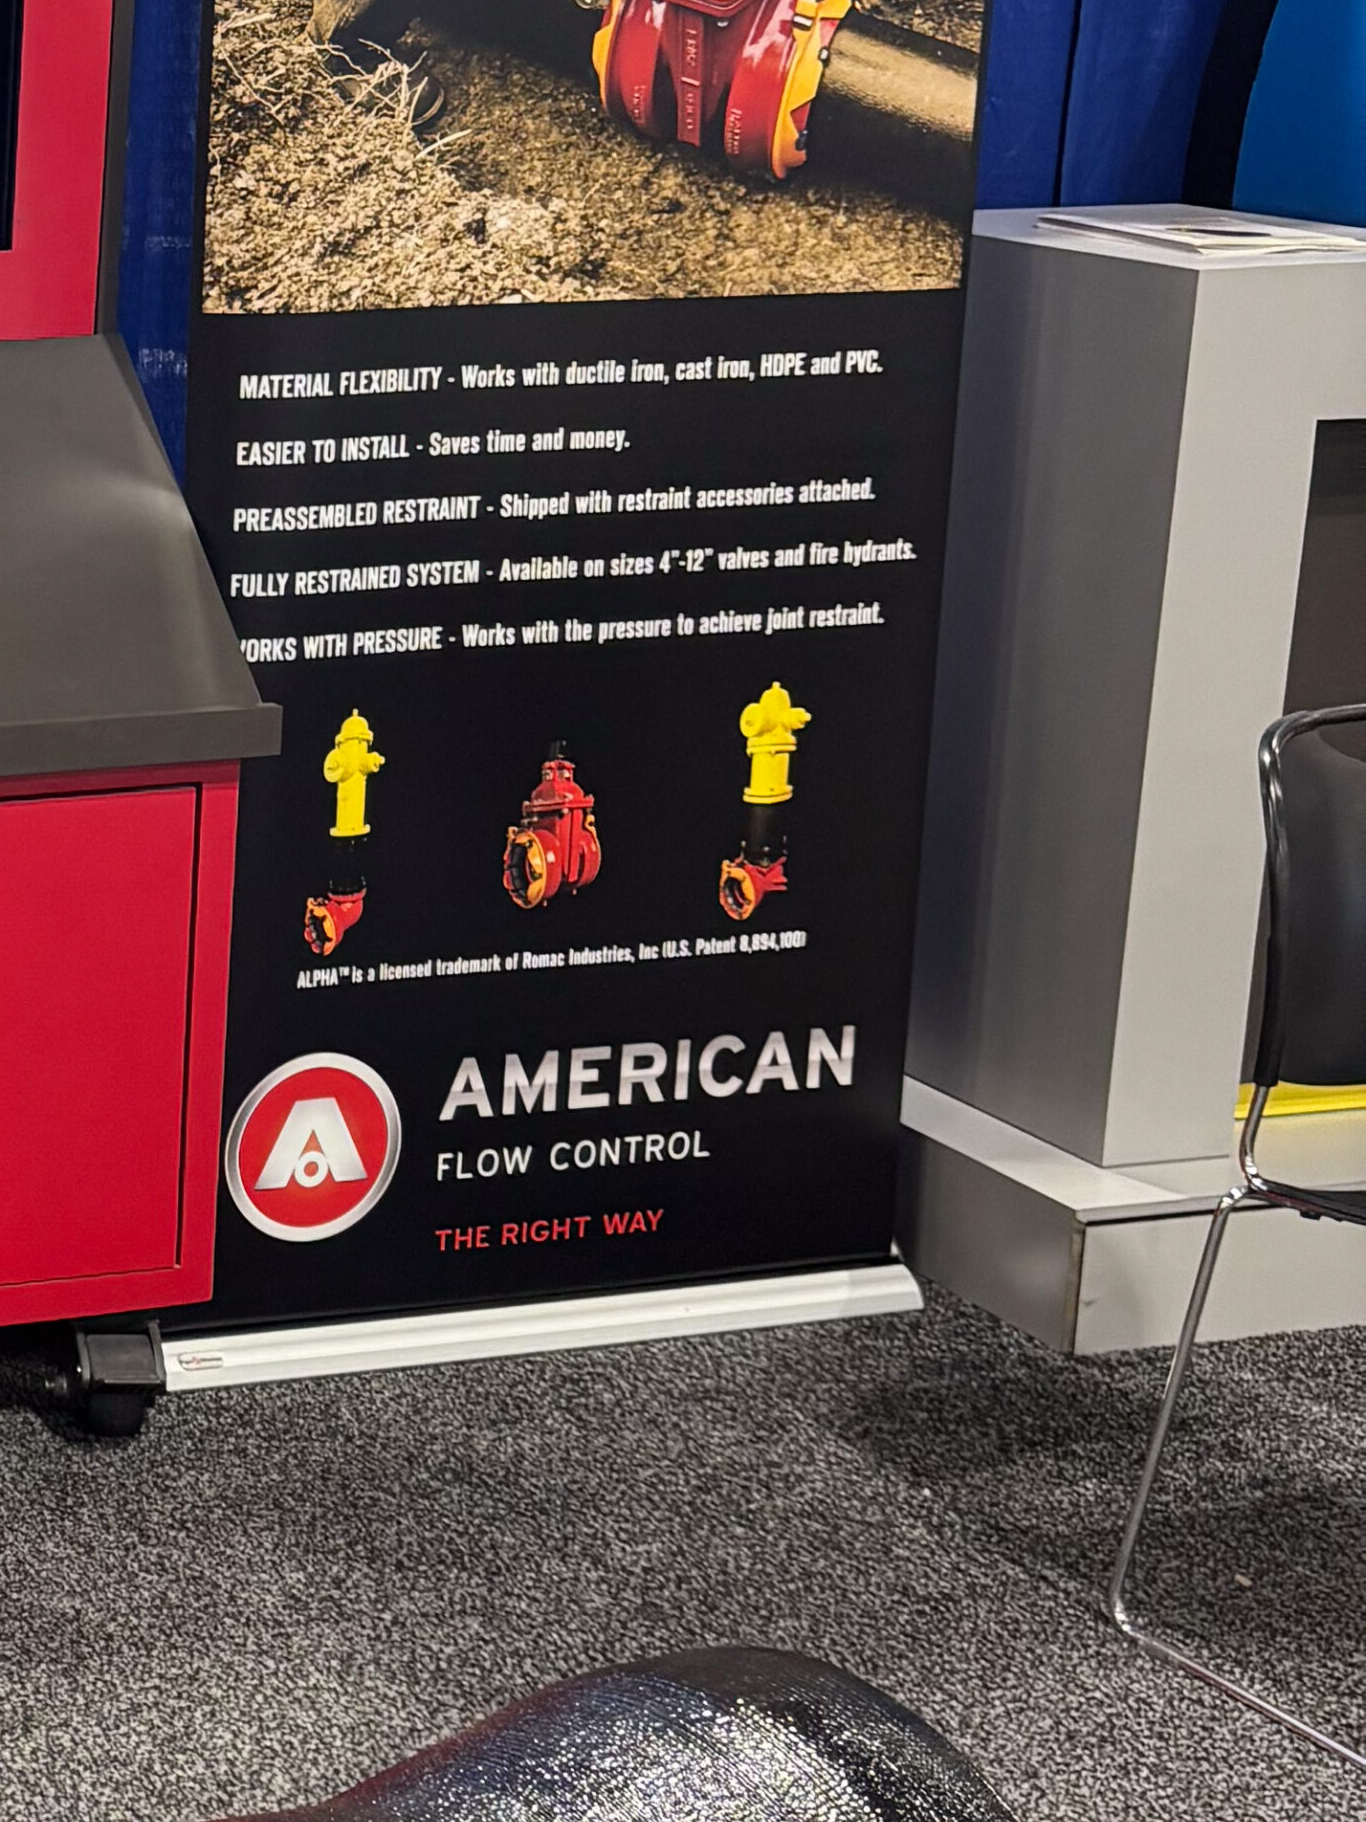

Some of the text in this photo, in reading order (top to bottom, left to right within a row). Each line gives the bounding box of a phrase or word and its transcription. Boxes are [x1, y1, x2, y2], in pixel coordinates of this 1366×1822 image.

[240, 349, 883, 399] MATERIAL FLEXIBILITY Works with ductile iron, cast iron, HDPE and PVC.
[237, 428, 630, 466] EASIER TO INSTALL Saves time and money.
[234, 477, 875, 532] PREASSEMBLED RESTRAINT Shipped with restraint accessories attached.
[231, 572, 289, 598] FULLY
[295, 565, 400, 595] RESTRAINED
[407, 559, 479, 588] SYSTEM
[499, 555, 578, 582] Available
[584, 558, 604, 577] on
[610, 552, 654, 576] sizes
[718, 546, 769, 570] valves
[774, 543, 805, 568] and
[810, 542, 838, 565] fire
[843, 538, 916, 567] hydrants.
[304, 602, 884, 660] WITH PRESSURE Works with the pressure to achieve joint restraint.
[380, 945, 635, 981] licensed trademark Romac Industries,
[439, 1025, 855, 1121] AMERICAN
[437, 1130, 709, 1181] FLOW CONTROL
[435, 1209, 663, 1251] THE RIGHT WAY
